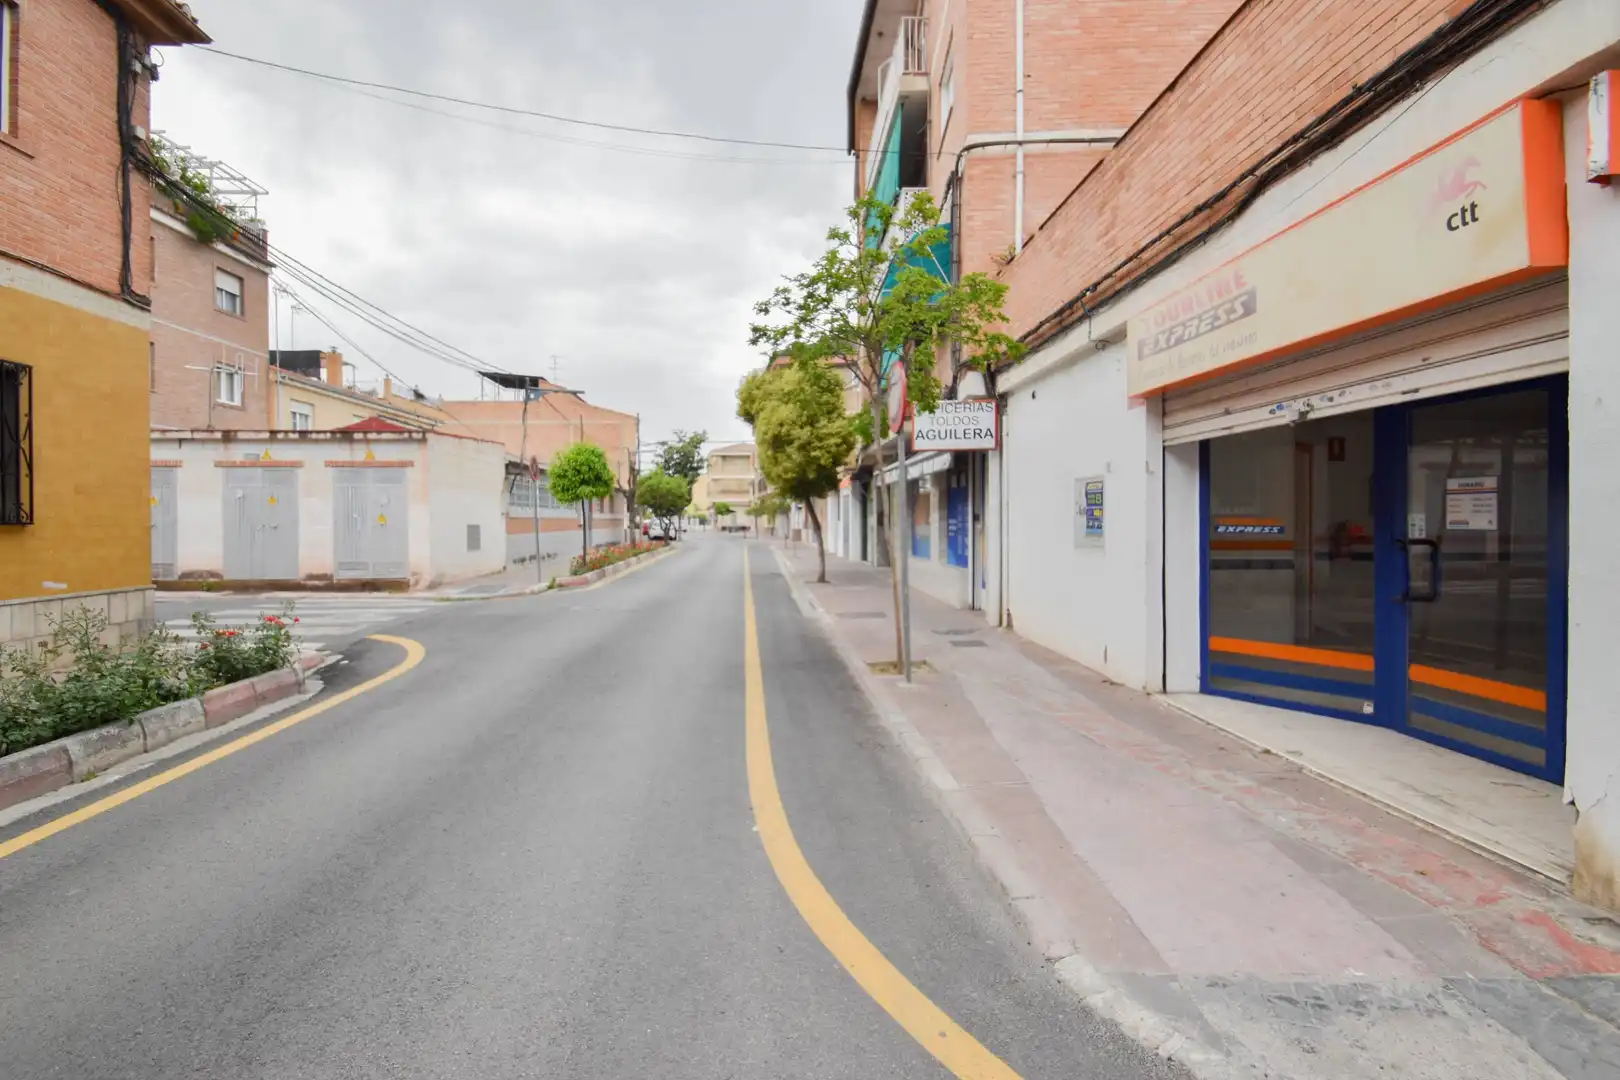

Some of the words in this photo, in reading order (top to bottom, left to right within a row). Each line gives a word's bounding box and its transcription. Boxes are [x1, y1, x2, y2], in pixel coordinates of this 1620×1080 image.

[1446, 200, 1480, 232] ctt
[1142, 293, 1249, 358] EXPRESS
[915, 401, 994, 414] ICERIAS
[929, 415, 980, 427] TOLDOS
[915, 427, 995, 441] AGUILERA
[1217, 525, 1281, 533] EXPRESS
